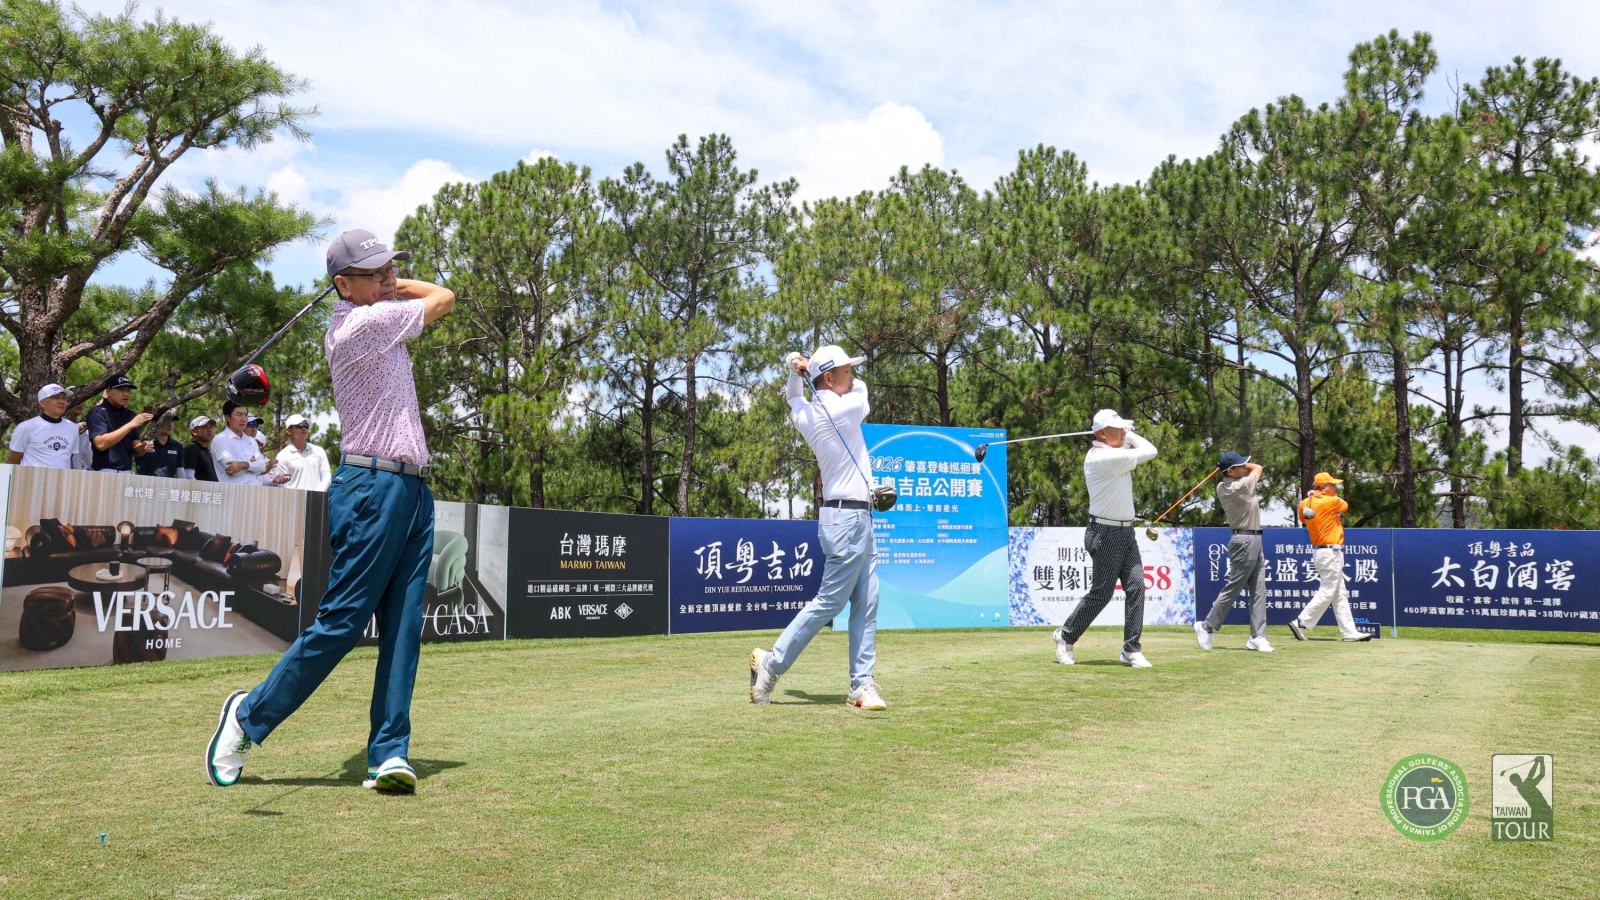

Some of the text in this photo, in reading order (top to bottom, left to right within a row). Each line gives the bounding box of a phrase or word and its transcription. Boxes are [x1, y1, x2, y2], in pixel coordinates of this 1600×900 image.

[905, 460, 982, 475] 肇喜登峰巡迴賽
[124, 486, 153, 500] 總代理
[560, 532, 627, 557] 台灣瑪摩
[1467, 540, 1536, 558] 頂粵吉品
[560, 560, 626, 570] MARMO TAIWAN
[694, 537, 814, 584] 頂粵吉品
[1431, 556, 1576, 591] 太白酒窖
[731, 585, 770, 593] RESTAURANT
[774, 584, 804, 592] TAICHUNG
[1524, 597, 1562, 607] 第一選擇
[93, 590, 235, 632] VERSACE
[433, 603, 490, 636] CASA
[550, 606, 572, 620] ABK
[578, 603, 608, 616] VERSACE
[145, 638, 182, 649] HOME
